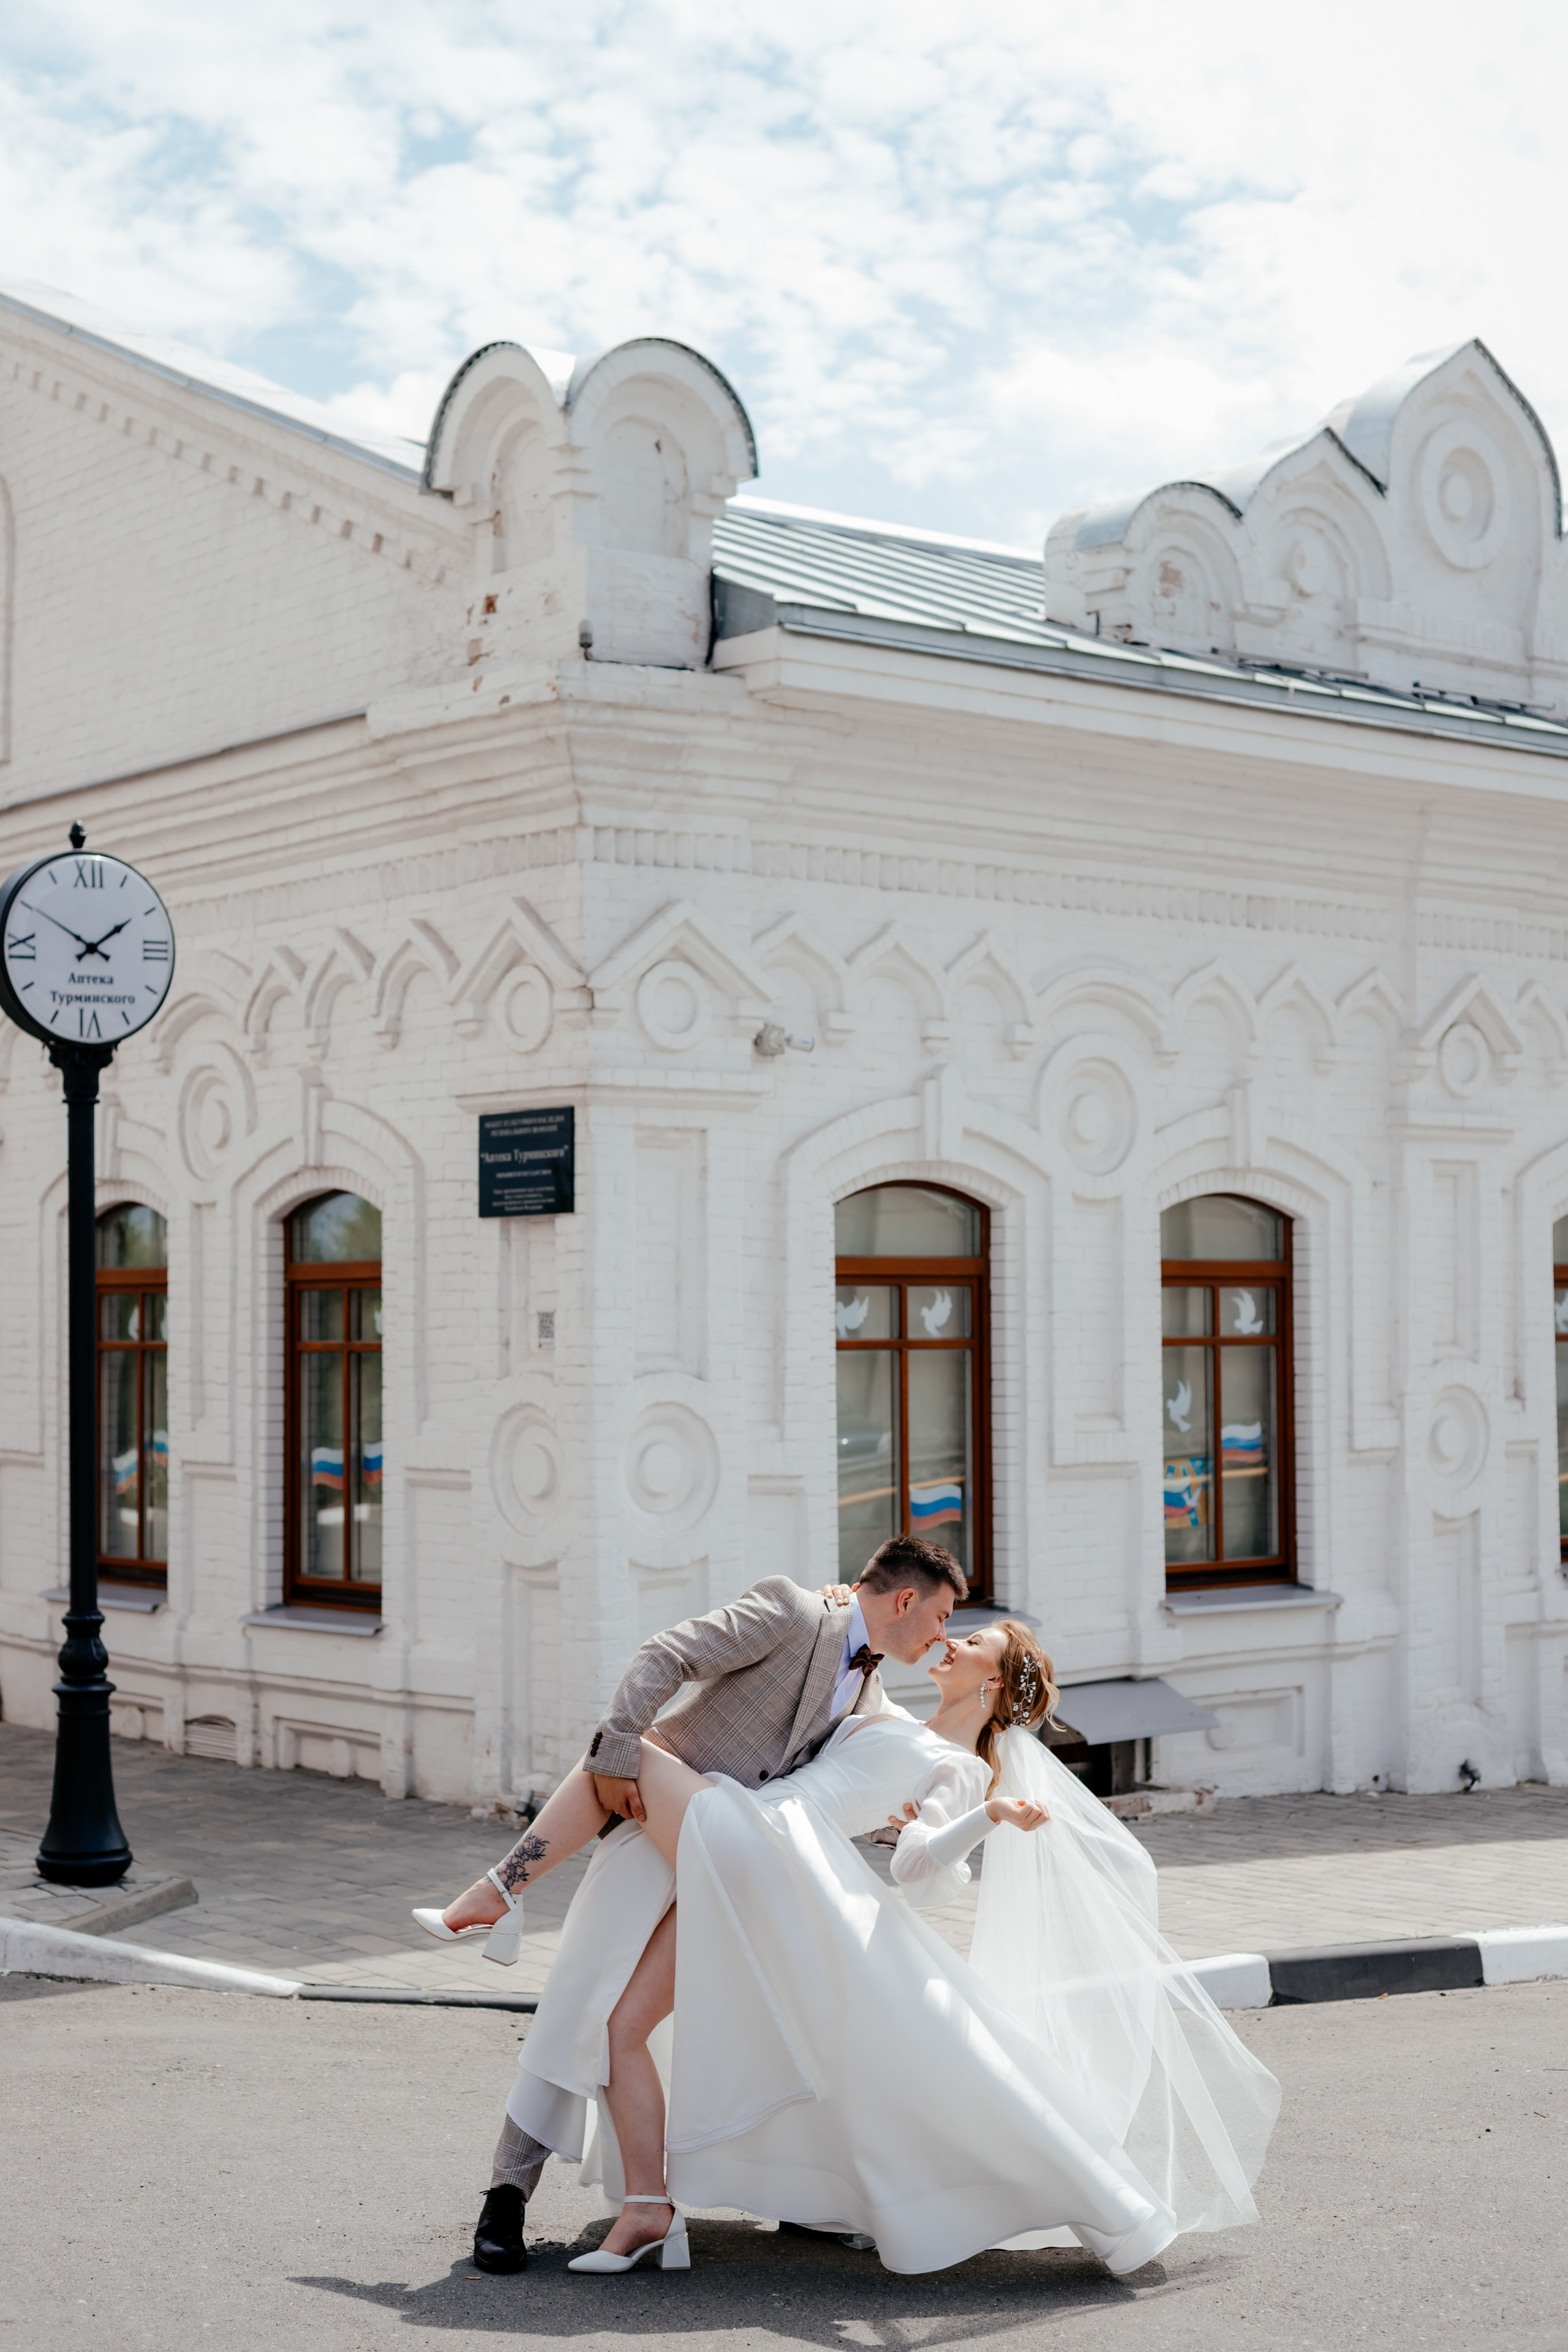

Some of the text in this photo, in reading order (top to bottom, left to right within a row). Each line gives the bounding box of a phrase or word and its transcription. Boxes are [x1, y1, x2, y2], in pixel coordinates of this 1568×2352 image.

[74, 860, 105, 889] XII
[7, 932, 36, 960] IX
[143, 940, 168, 962] III
[68, 972, 114, 985] Аптека
[50, 991, 135, 1007] Турминского
[79, 1008, 102, 1038] VI
